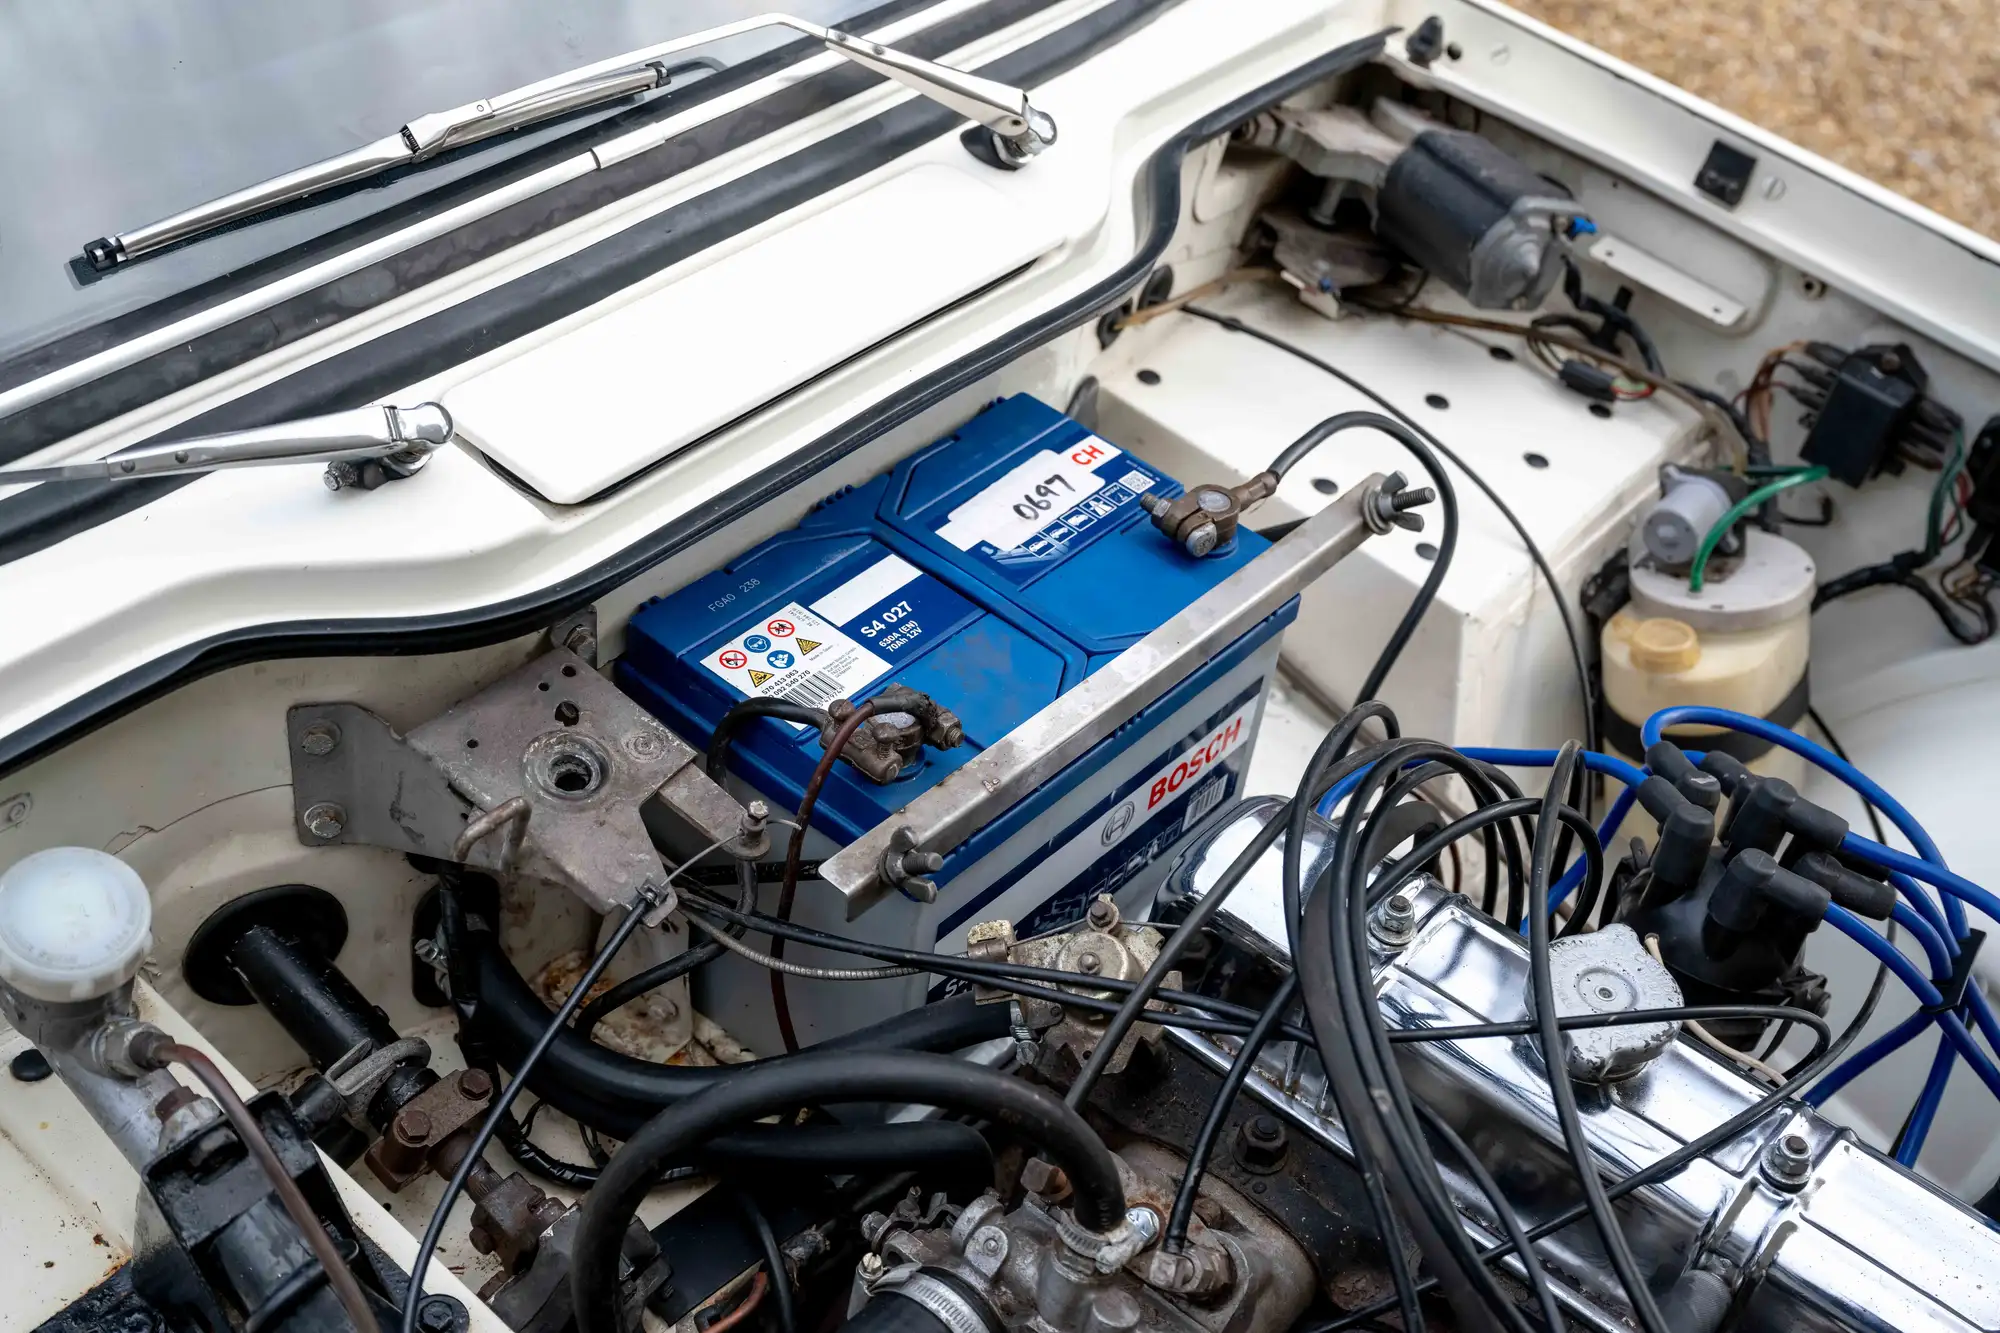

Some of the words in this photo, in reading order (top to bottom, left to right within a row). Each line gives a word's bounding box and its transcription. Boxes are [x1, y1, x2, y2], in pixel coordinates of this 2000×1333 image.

[1071, 444, 1105, 466] CH
[1013, 473, 1076, 520] 0697
[739, 578, 761, 593] 238
[860, 619, 886, 638] S4
[882, 600, 913, 623] 027
[878, 632, 901, 647] 630A
[898, 619, 918, 634] (EN)
[885, 637, 909, 652] 70Ah
[906, 626, 922, 639] 12V
[761, 685, 775, 695] 570
[774, 677, 787, 687] 413
[1147, 716, 1243, 811] BOSCH
